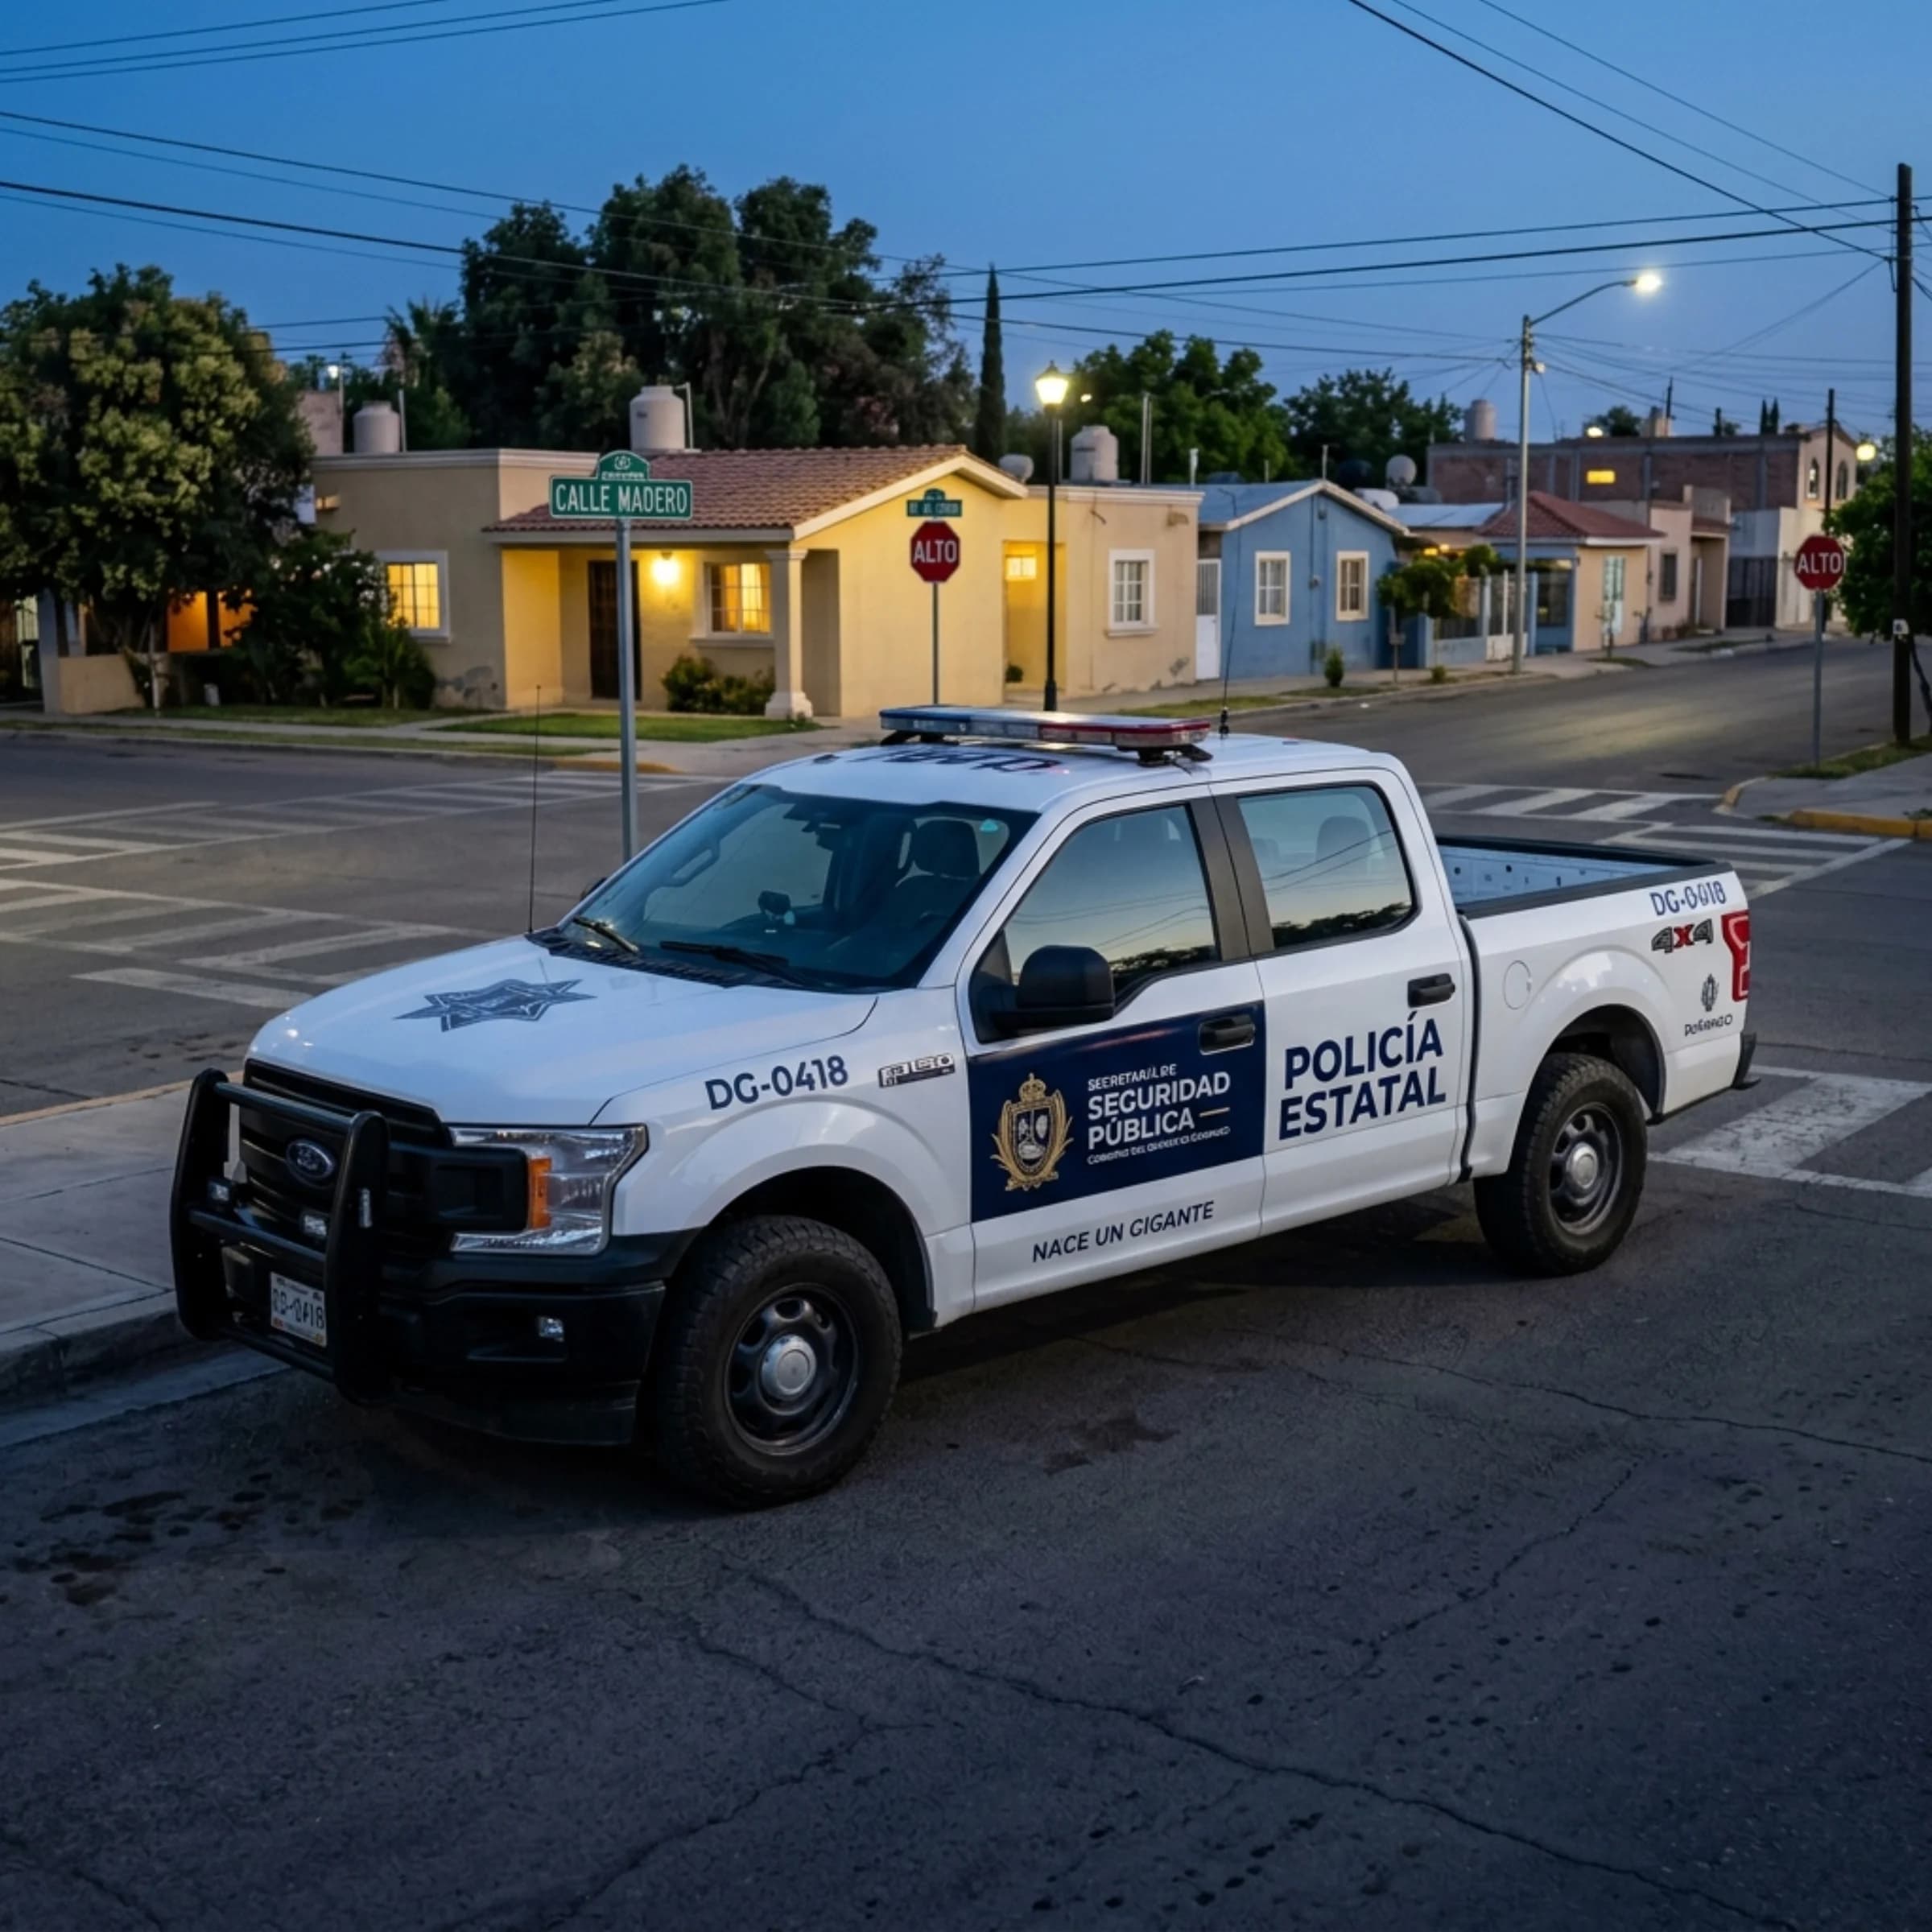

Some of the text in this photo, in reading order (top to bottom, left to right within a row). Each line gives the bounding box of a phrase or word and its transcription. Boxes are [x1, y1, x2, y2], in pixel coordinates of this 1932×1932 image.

[555, 484, 687, 514] CALLE MADERO
[913, 539, 957, 564] ALTO
[1796, 551, 1841, 574] ALTO
[1285, 1010, 1443, 1090] POLICÍA
[704, 1055, 849, 1110] DG-0418
[1088, 1071, 1231, 1121] SEGURIDAD
[1278, 1066, 1447, 1141] ESTATAL
[1088, 1107, 1195, 1150] PÚBLICA
[1032, 1200, 1215, 1263] NACE UN GIGANTE
